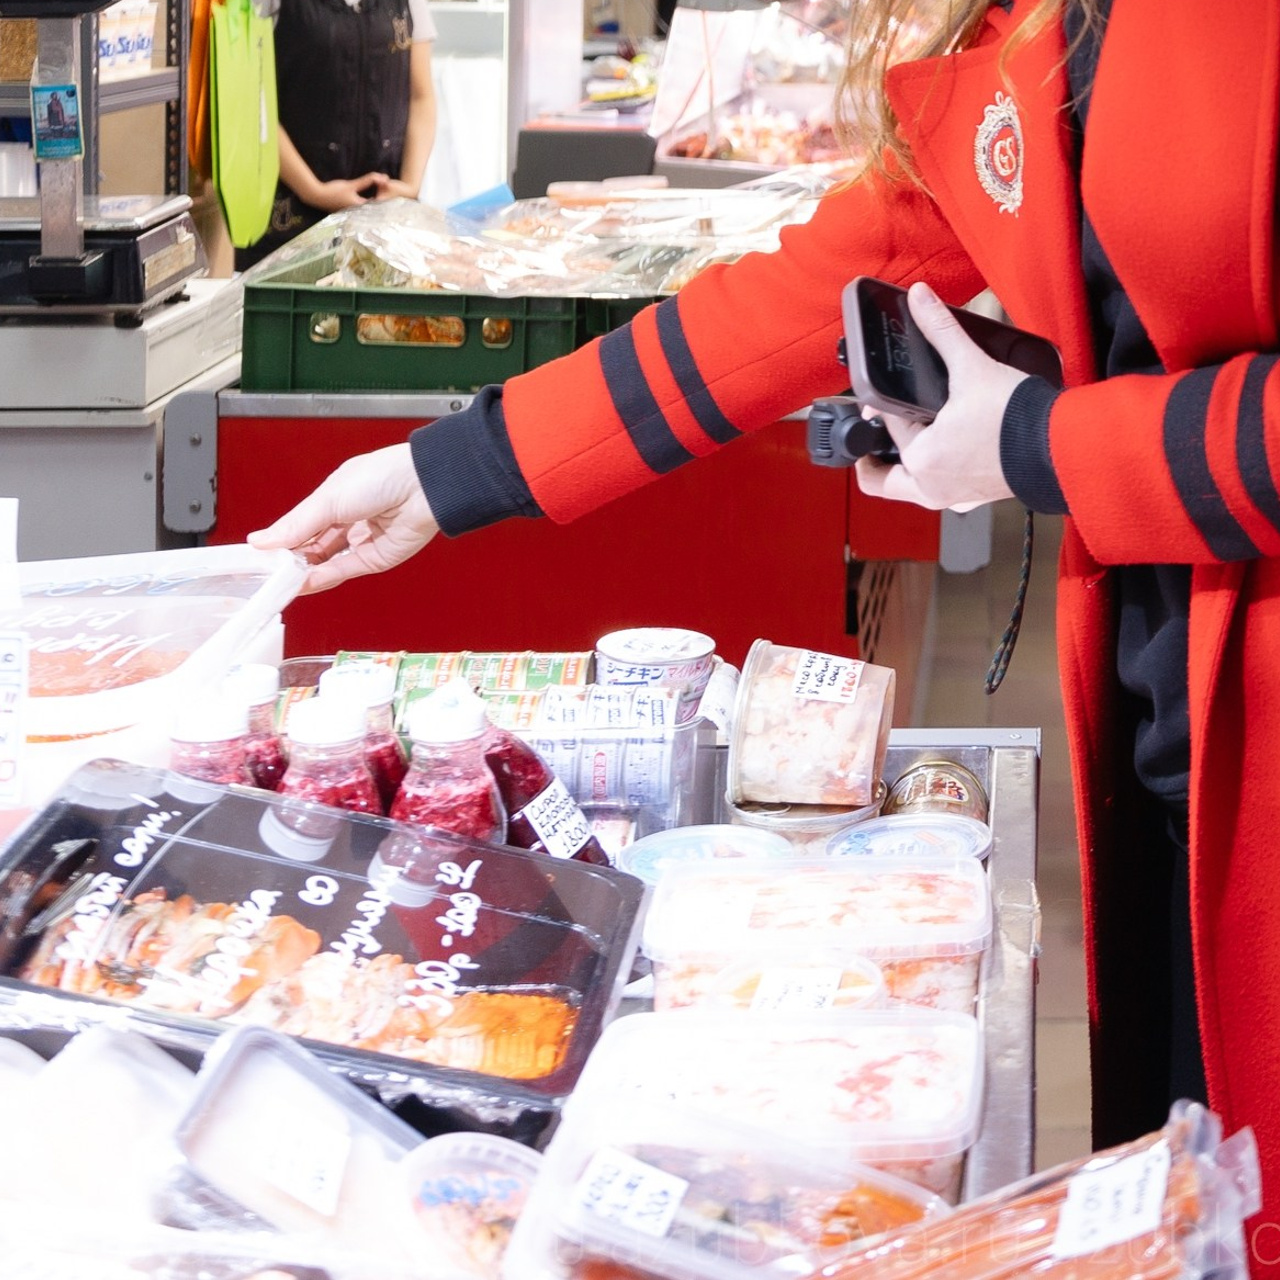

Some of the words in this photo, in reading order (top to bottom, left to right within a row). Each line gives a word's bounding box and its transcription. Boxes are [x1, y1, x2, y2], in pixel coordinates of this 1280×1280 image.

[607, 662, 664, 680] シーチキン
